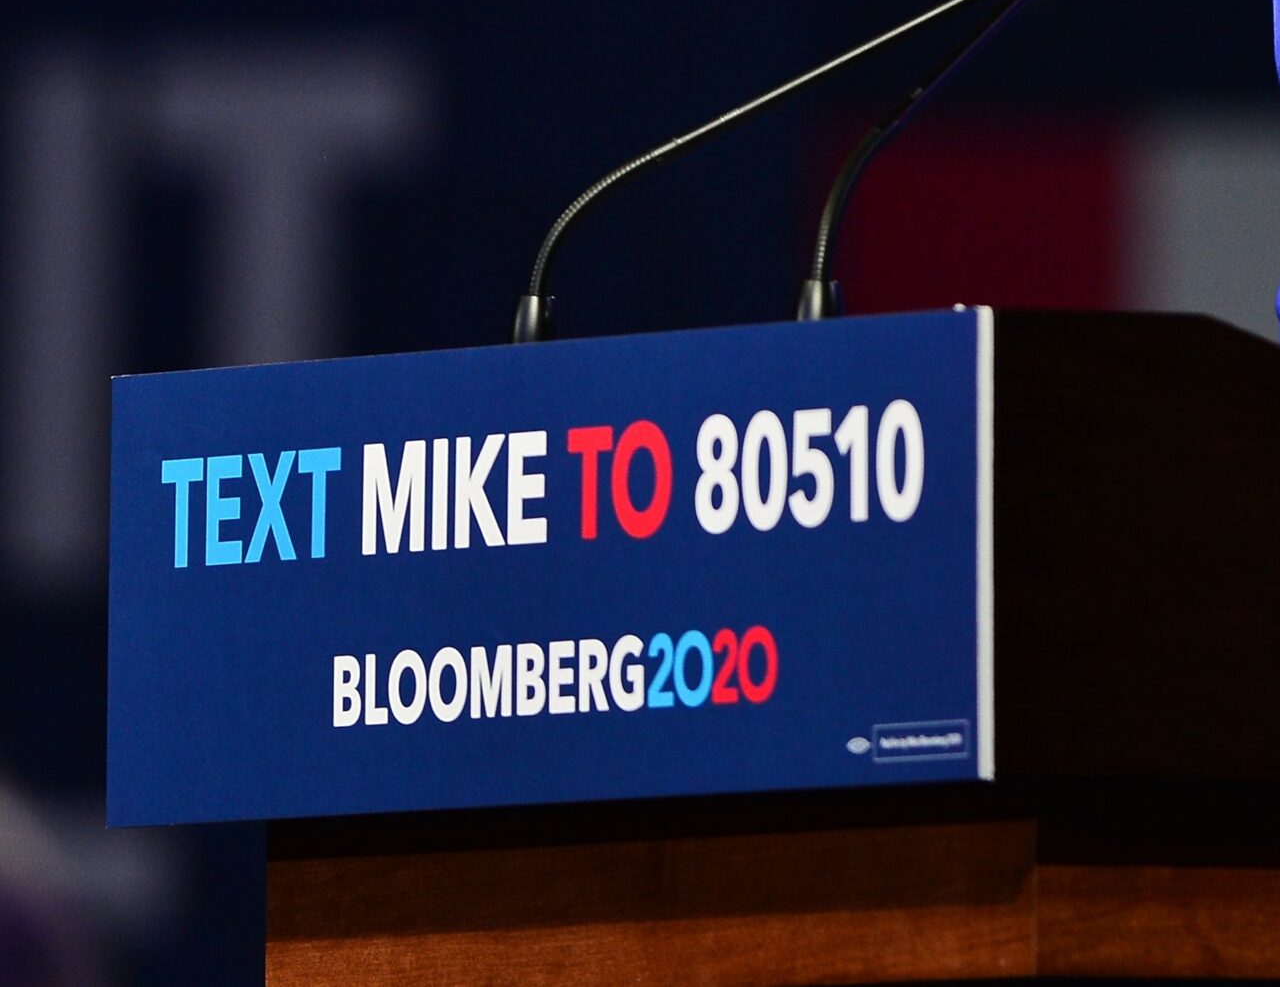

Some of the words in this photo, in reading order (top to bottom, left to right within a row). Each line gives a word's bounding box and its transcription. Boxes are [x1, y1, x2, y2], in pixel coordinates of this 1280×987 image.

[161, 446, 342, 569] TEXT
[361, 430, 548, 556] MIKE
[566, 418, 674, 541] TO
[694, 398, 925, 535] 80510
[332, 624, 780, 728] BLOOMBERG2020
